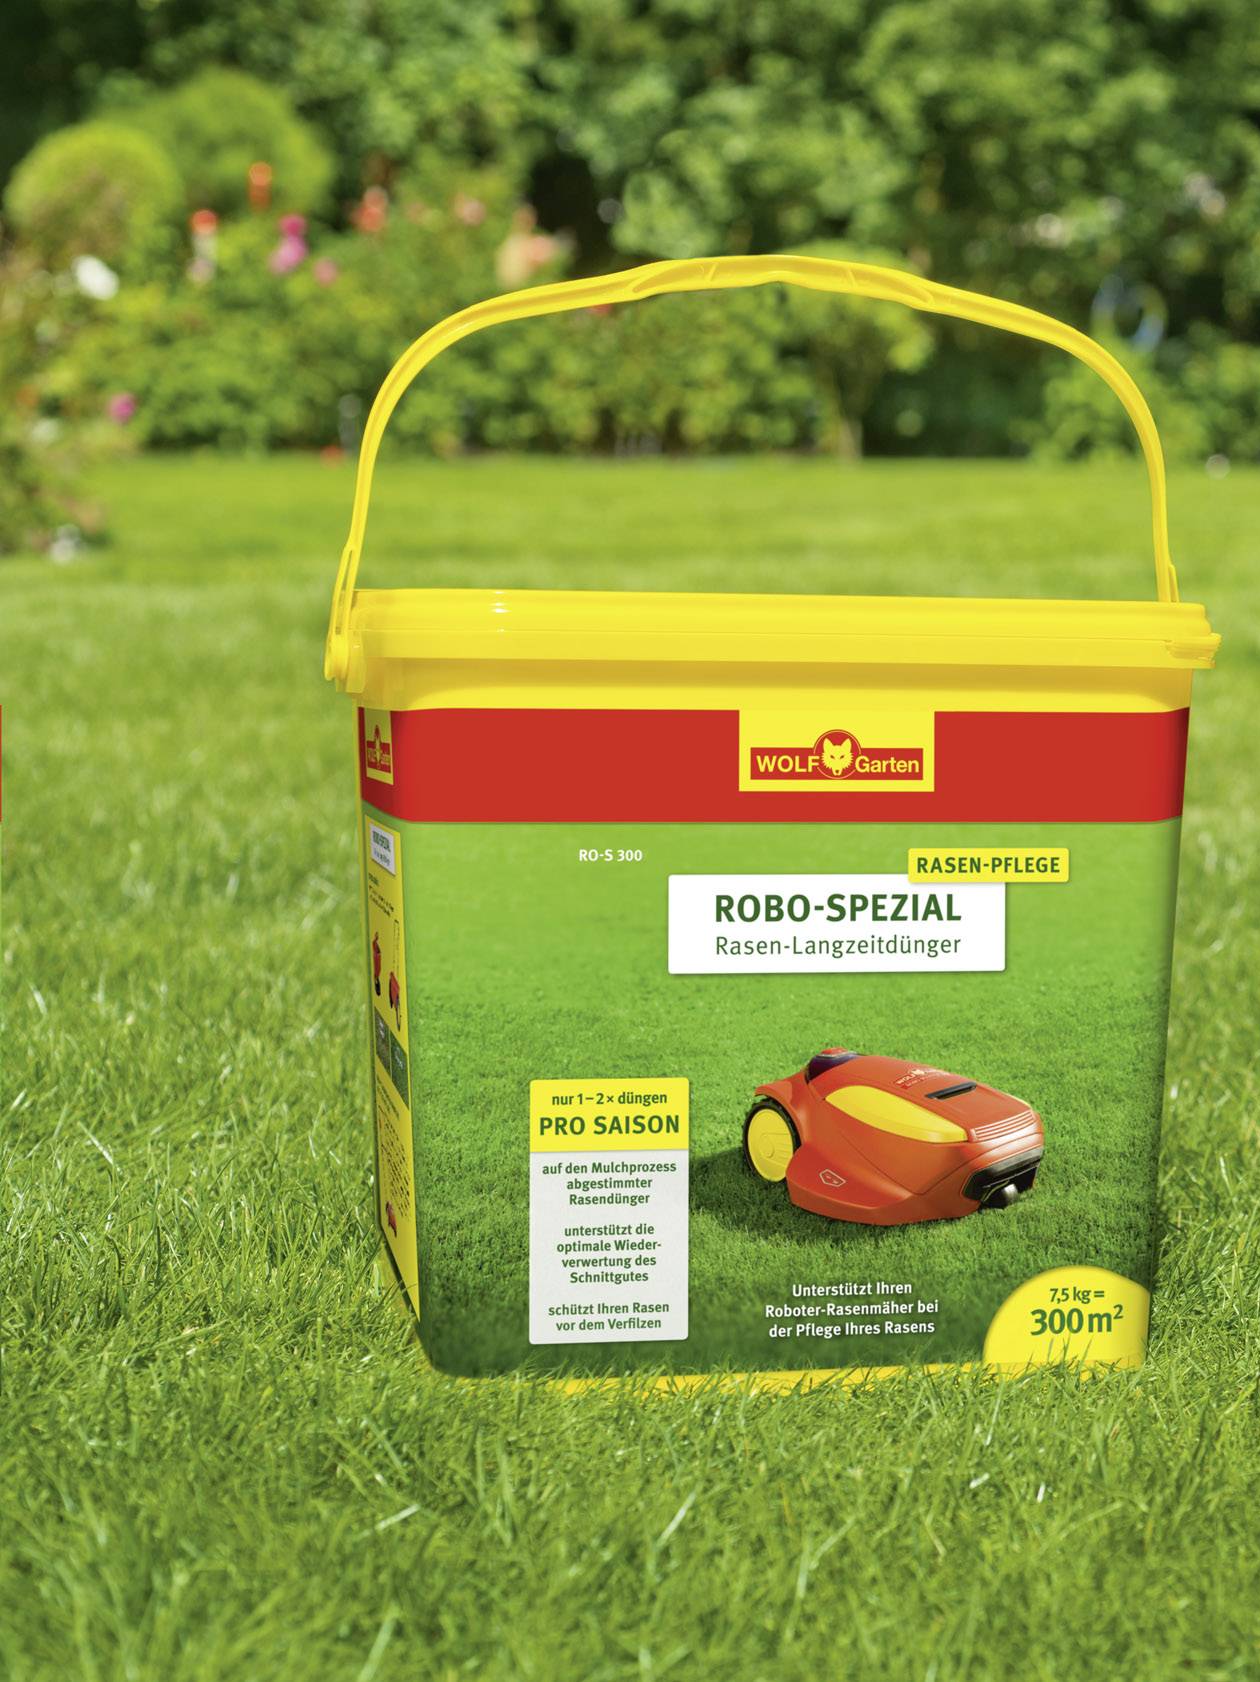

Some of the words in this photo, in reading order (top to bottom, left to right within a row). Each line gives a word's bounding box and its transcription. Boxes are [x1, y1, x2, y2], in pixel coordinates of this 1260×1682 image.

[756, 755, 820, 772] WOLF
[855, 756, 919, 773] Garten
[579, 849, 613, 861] RO-S
[617, 849, 642, 861] 300
[917, 857, 1060, 874] RASEN-PFLEGE
[715, 893, 962, 922] ROBO-SPEZIAL
[716, 935, 961, 959] Rasen-Langzeitdünger
[552, 1095, 574, 1105] nur
[618, 1092, 667, 1106] düngen
[540, 1117, 585, 1135] PRO
[594, 1115, 679, 1134] SAISON
[543, 1163, 562, 1174] auf
[565, 1163, 587, 1174] den
[592, 1162, 677, 1175] Mulchprozess
[567, 1178, 652, 1191] abgestimmter
[570, 1193, 650, 1206] Rasendünger
[564, 1224, 632, 1236] unterstützt
[636, 1224, 654, 1234] die
[557, 1241, 611, 1254] optimale
[615, 1239, 661, 1250] Wieder-
[562, 1257, 631, 1269] verwertung
[635, 1255, 656, 1265] des
[570, 1271, 648, 1284] Schnittgutes
[792, 1283, 872, 1296] Unterstützt
[876, 1282, 912, 1294] Ihren
[1050, 1288, 1069, 1304] 7,5
[548, 1304, 594, 1315] schützt
[598, 1303, 628, 1314] Ihren
[633, 1303, 669, 1313] Rasen
[765, 1302, 913, 1318] Roboter-Rasenmäher
[918, 1300, 938, 1312] bei
[556, 1322, 575, 1331] vor
[579, 1320, 604, 1330] dem
[608, 1318, 661, 1329] Verfilzen
[769, 1325, 792, 1337] der
[796, 1323, 841, 1338] Pflege
[845, 1322, 880, 1335] Ihres
[885, 1321, 935, 1333] Rasens
